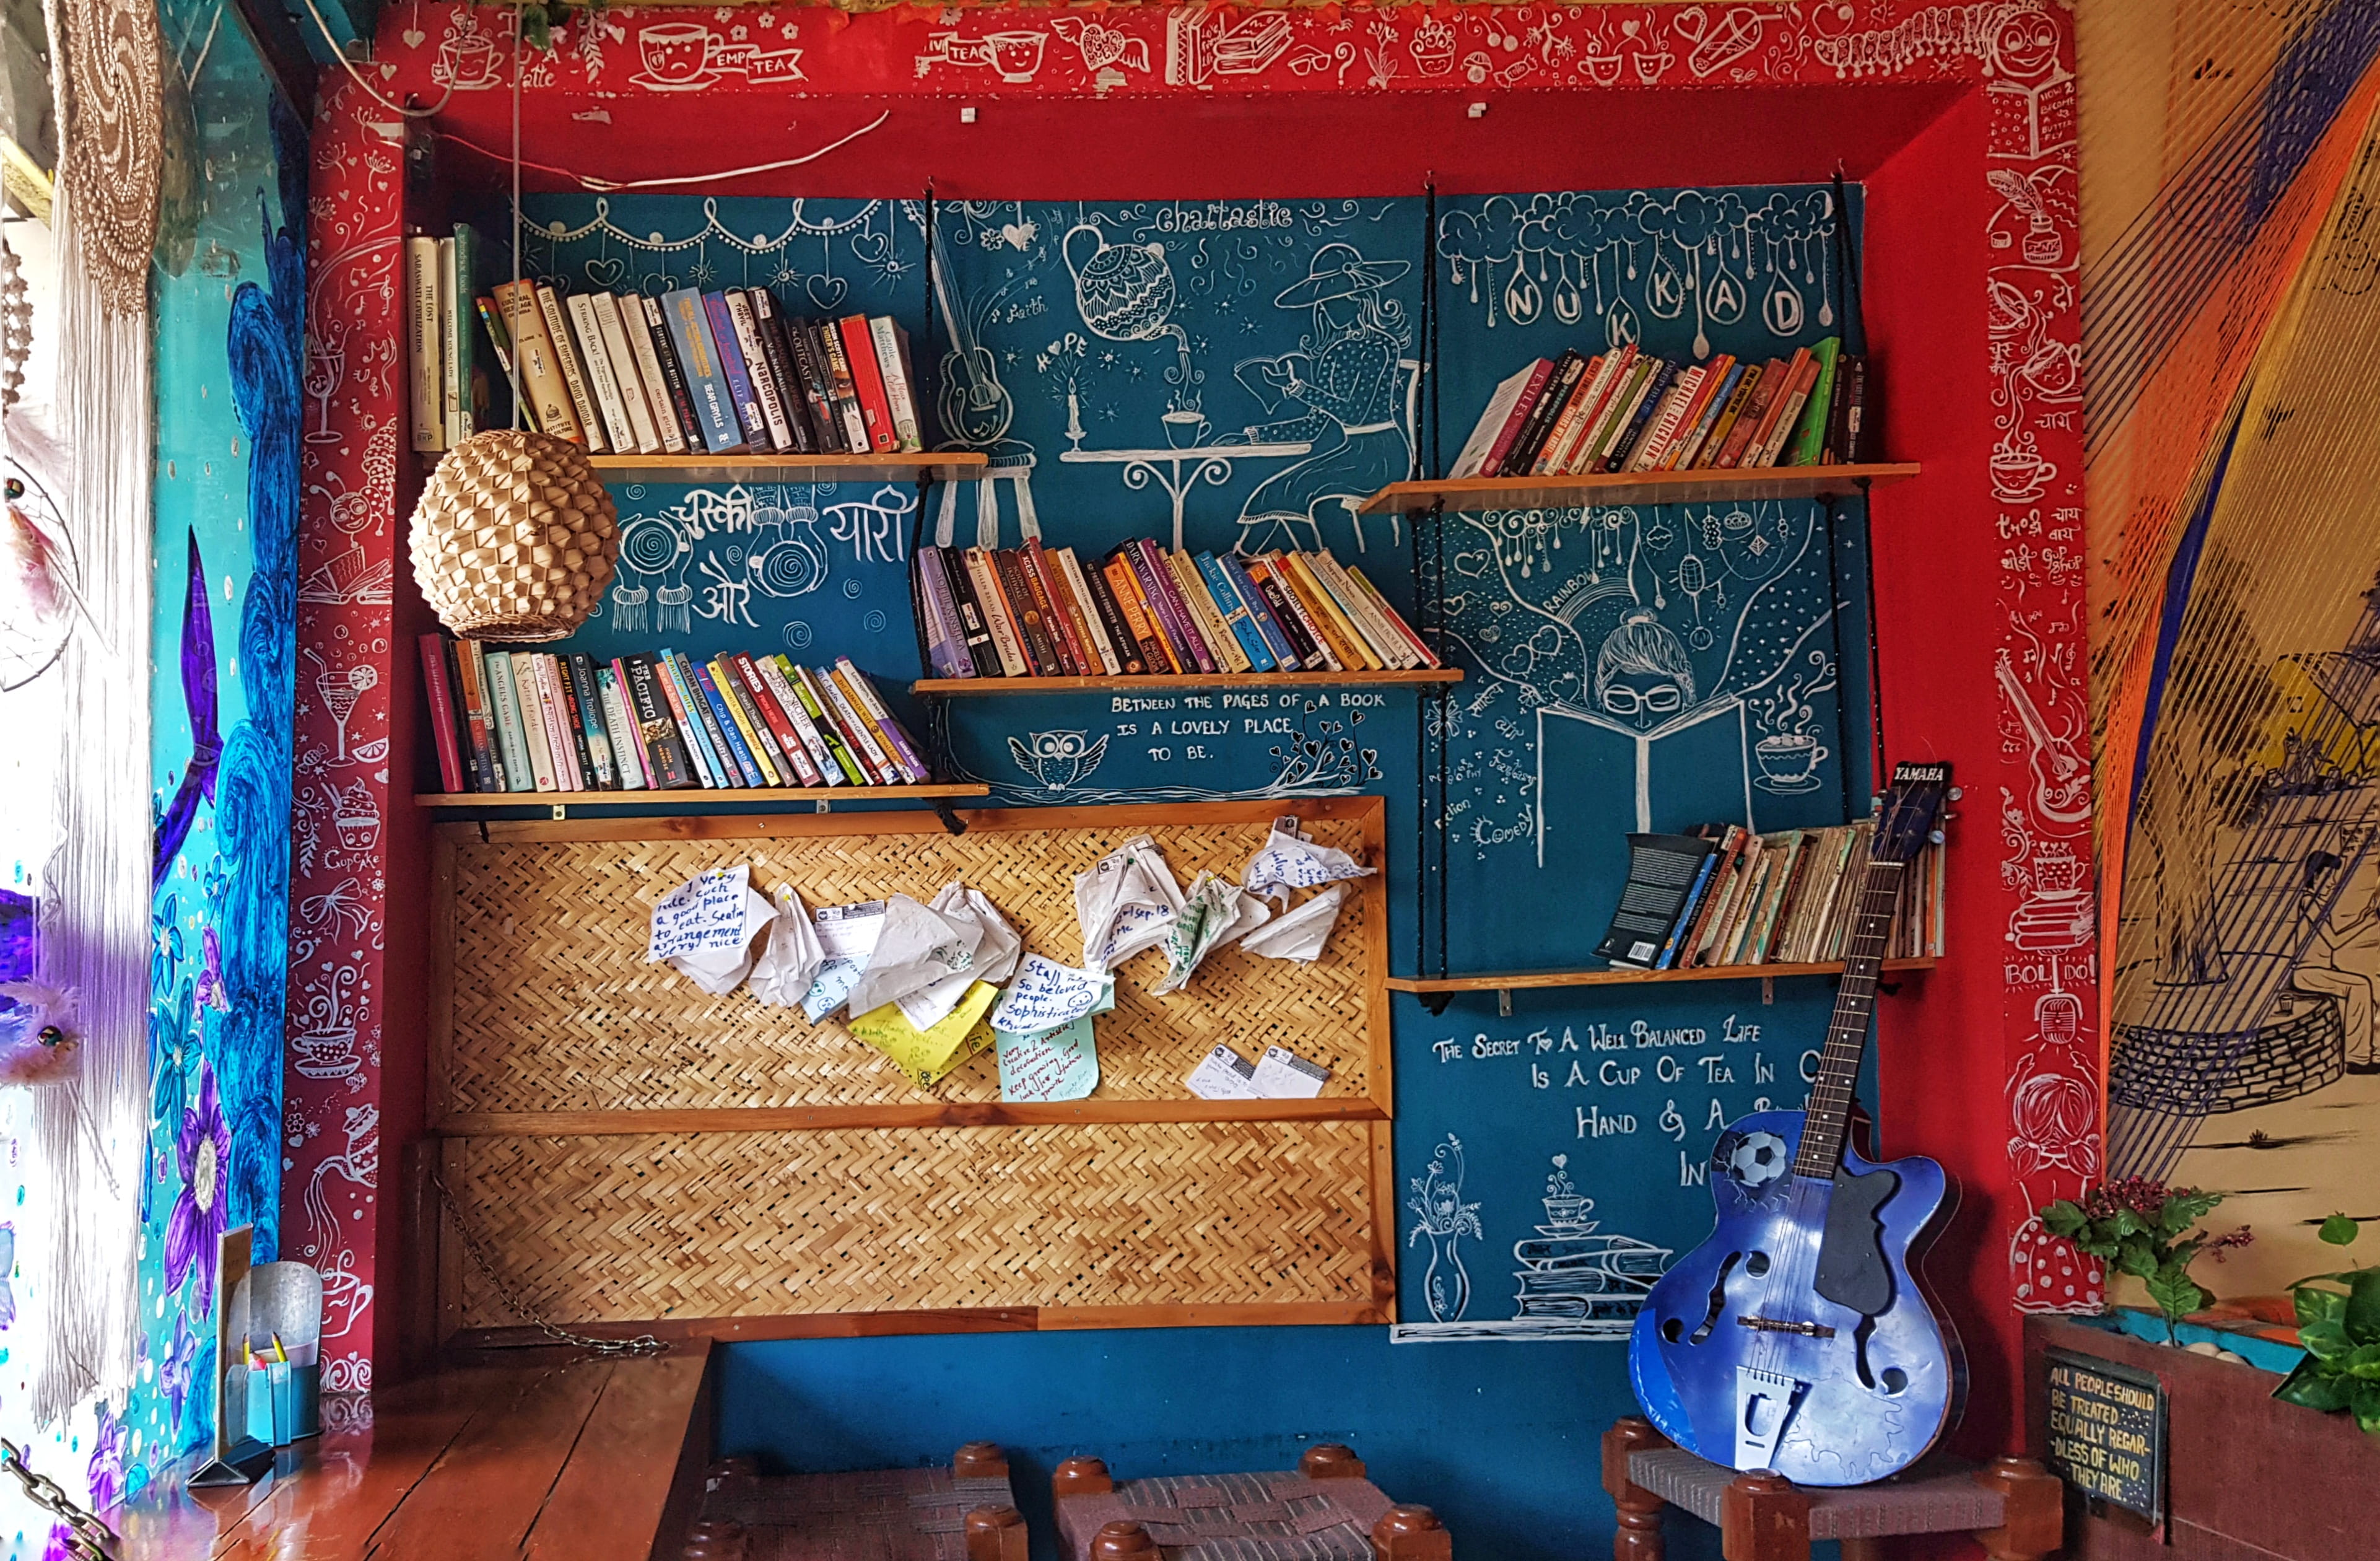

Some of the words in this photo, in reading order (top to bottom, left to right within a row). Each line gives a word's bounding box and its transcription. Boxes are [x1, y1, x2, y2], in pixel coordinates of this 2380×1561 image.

[754, 58, 787, 74] TEA
[949, 46, 979, 59] TEA
[2041, 97, 2075, 115] BECOME
[2065, 82, 2075, 95] 2
[578, 302, 591, 333] STRIKING
[587, 334, 599, 356] BACK!
[878, 325, 890, 369] Matthews
[885, 332, 896, 359] Carole
[546, 301, 560, 331] SOLITUDE
[559, 343, 576, 377] EMPERORS
[570, 380, 583, 399] DAVID
[577, 399, 592, 427] DAVIDAR
[822, 326, 835, 354] ENDER'S
[829, 354, 840, 372] GAME
[828, 323, 837, 340] ORSON
[833, 340, 843, 357] SCOTT
[839, 356, 847, 372] CARD
[772, 358, 787, 393] NAIPAUL
[1571, 372, 1595, 408] TOMLINSON
[1671, 367, 1704, 411] MICHAEL
[655, 388, 668, 413] certain
[704, 384, 715, 402] BEAR
[710, 401, 724, 429] GRYLLS
[1514, 373, 1545, 418] EXILES
[1544, 385, 1568, 424] PERSEPOLIS
[1559, 406, 1577, 429] CHEERS
[1645, 413, 1678, 460] CRICHTON
[692, 550, 761, 627] और
[1022, 556, 1035, 578] XCESS
[1031, 577, 1049, 610] BAGGAGE
[1126, 541, 1142, 565] DARK
[1138, 563, 1157, 600] WARNING
[1200, 556, 1219, 583] Jackie
[1216, 582, 1236, 611] Collins
[1115, 579, 1133, 606] ANNE
[1128, 605, 1148, 636] PERRY
[1168, 590, 1180, 607] CAN
[1178, 607, 1190, 627] HAVE
[1190, 635, 1203, 652] ALL?
[946, 604, 966, 650] KINSELLA
[991, 614, 1004, 636] War
[1000, 633, 1016, 663] Brides
[1035, 634, 1047, 654] AMISH
[1302, 614, 1325, 645] CHOICE
[1118, 635, 1131, 658] AFGHAN
[559, 662, 570, 682] RIGHT
[564, 682, 572, 694] FIT
[642, 664, 652, 680] THE
[738, 657, 763, 693] STORIES
[567, 694, 578, 715] WRONG
[578, 668, 591, 696] Joanna
[585, 698, 598, 729] Trollope
[603, 693, 611, 707] THE
[631, 668, 656, 719] PACIFIC
[682, 694, 695, 714] BITES
[739, 693, 752, 709] Shashi
[750, 709, 762, 729] Tharoor
[1111, 697, 1175, 712] BETWEEN
[1184, 696, 1213, 709] THE
[1223, 694, 1269, 708] PAGES
[1279, 694, 1301, 707] OF
[1319, 694, 1330, 707] A
[1340, 693, 1386, 707] BOOK
[573, 715, 581, 729] SHOE
[606, 707, 621, 734] DEATH
[680, 660, 695, 687] CHETAN
[692, 687, 710, 715] BHAGAT
[705, 715, 716, 732] half
[712, 733, 733, 769] girlfriend
[716, 703, 726, 722] Chip
[728, 726, 737, 740] Dan
[735, 741, 748, 761] Heath
[1117, 723, 1137, 736] IS
[1152, 723, 1162, 735] A
[1171, 719, 1231, 735] LOVELY
[1245, 717, 1293, 733] PLACE
[614, 737, 630, 774] INSTINCT
[657, 744, 669, 770] AMBROSE
[665, 747, 674, 763] HUGH
[1148, 747, 1172, 762] TO
[1187, 746, 1214, 759] BE.
[1894, 766, 1944, 782] YAMAHA
[656, 916, 668, 925] a
[673, 903, 699, 925] good
[704, 894, 738, 911] place
[655, 930, 671, 940] to
[1432, 1038, 1463, 1064] THE
[1471, 1033, 1520, 1059] SECRET
[1558, 1030, 1579, 1053] A
[1630, 1020, 1706, 1048] BALANCED
[1723, 1014, 1761, 1043] LIFE
[1564, 1060, 1590, 1087] A
[1599, 1060, 1641, 1087] CUP
[1656, 1056, 1685, 1083] OF
[1698, 1053, 1735, 1084] TEA
[1754, 1052, 1774, 1084] IN
[1576, 1106, 1637, 1139] HAND
[1704, 1098, 1729, 1130] A
[2051, 1367, 2071, 1386] ALL
[2075, 1371, 2112, 1399] PEOPLE
[2114, 1384, 2155, 1411] SHOULD
[2051, 1388, 2067, 1410] BE
[2070, 1395, 2119, 1425] TREATED
[2051, 1410, 2106, 1446] EQUALLY
[2071, 1463, 2100, 1489] THEY
[2091, 1446, 2108, 1468] OF
[2109, 1455, 2140, 1481] WHO
